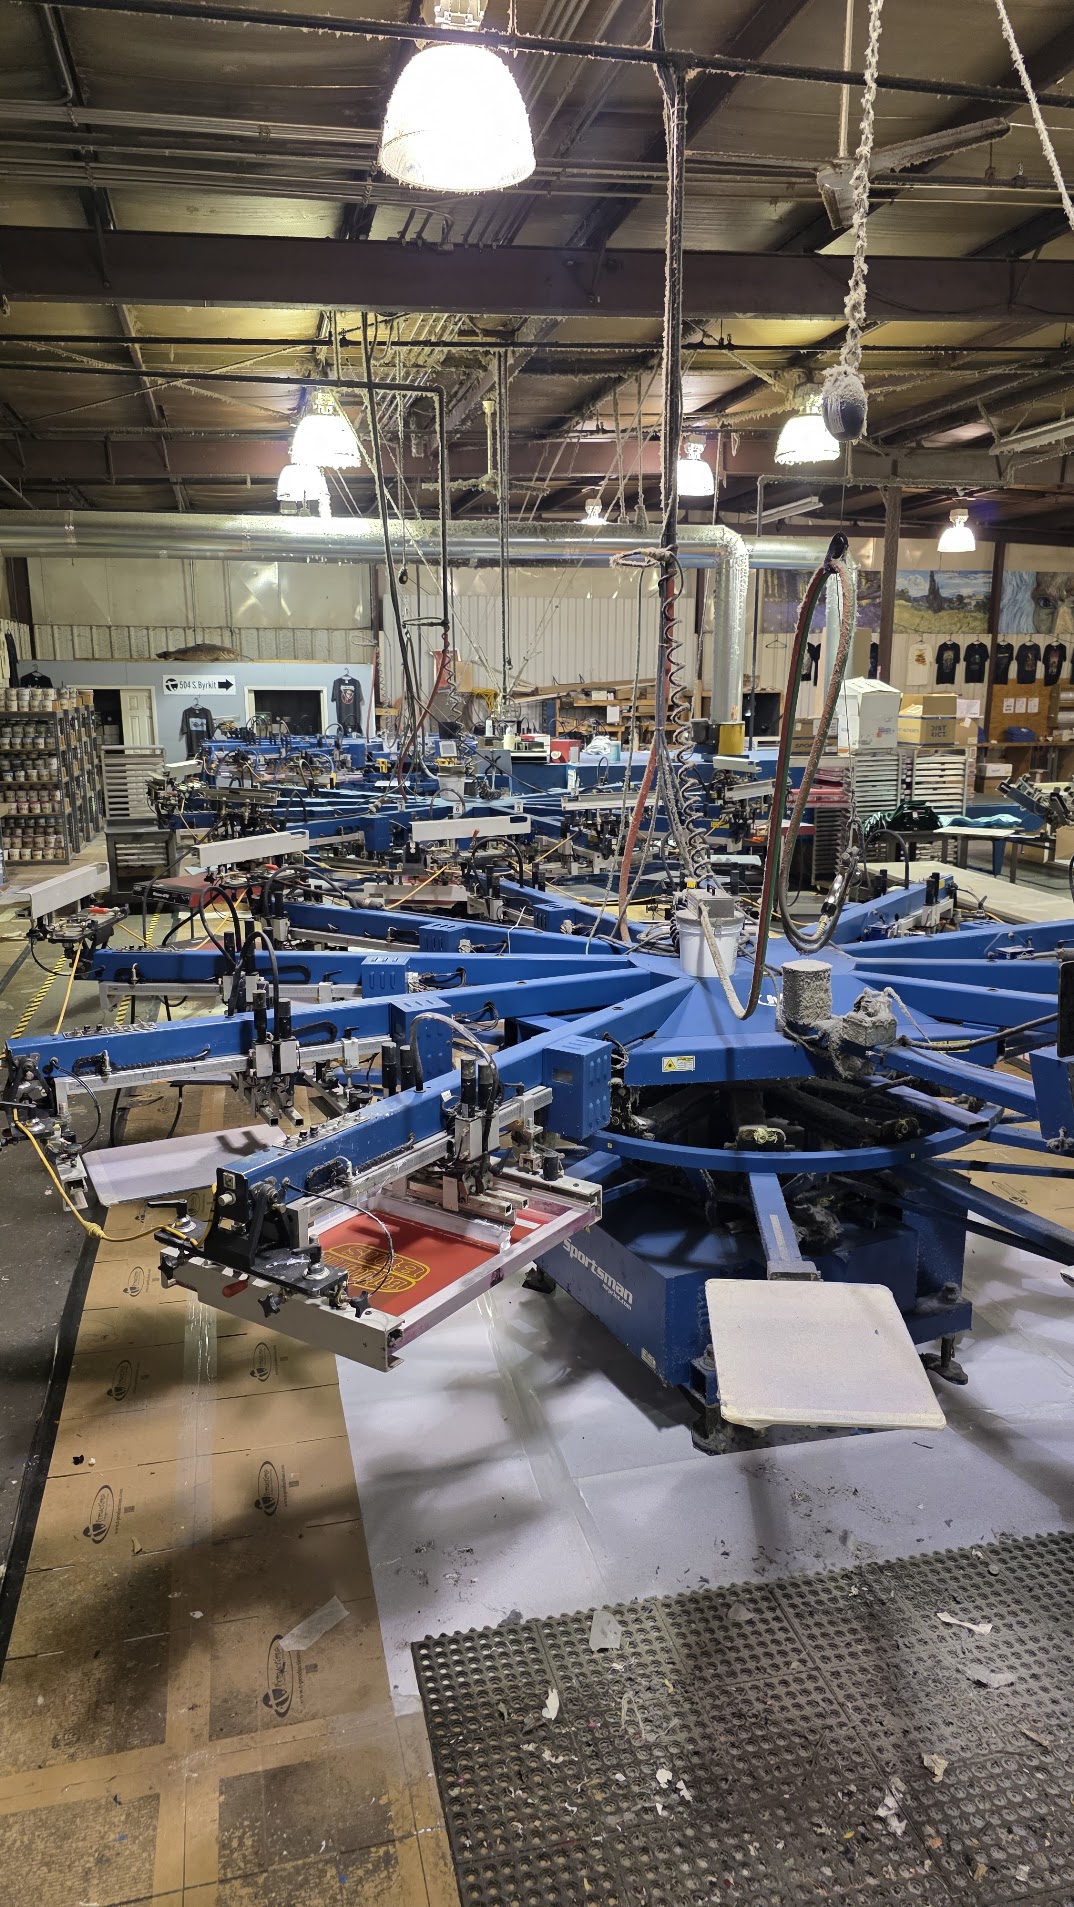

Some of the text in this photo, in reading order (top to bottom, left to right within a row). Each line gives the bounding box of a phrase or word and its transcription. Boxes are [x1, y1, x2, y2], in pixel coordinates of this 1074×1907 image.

[180, 681, 191, 689] 504
[198, 681, 217, 690] Byrkit
[563, 1238, 633, 1304] Sportsman
